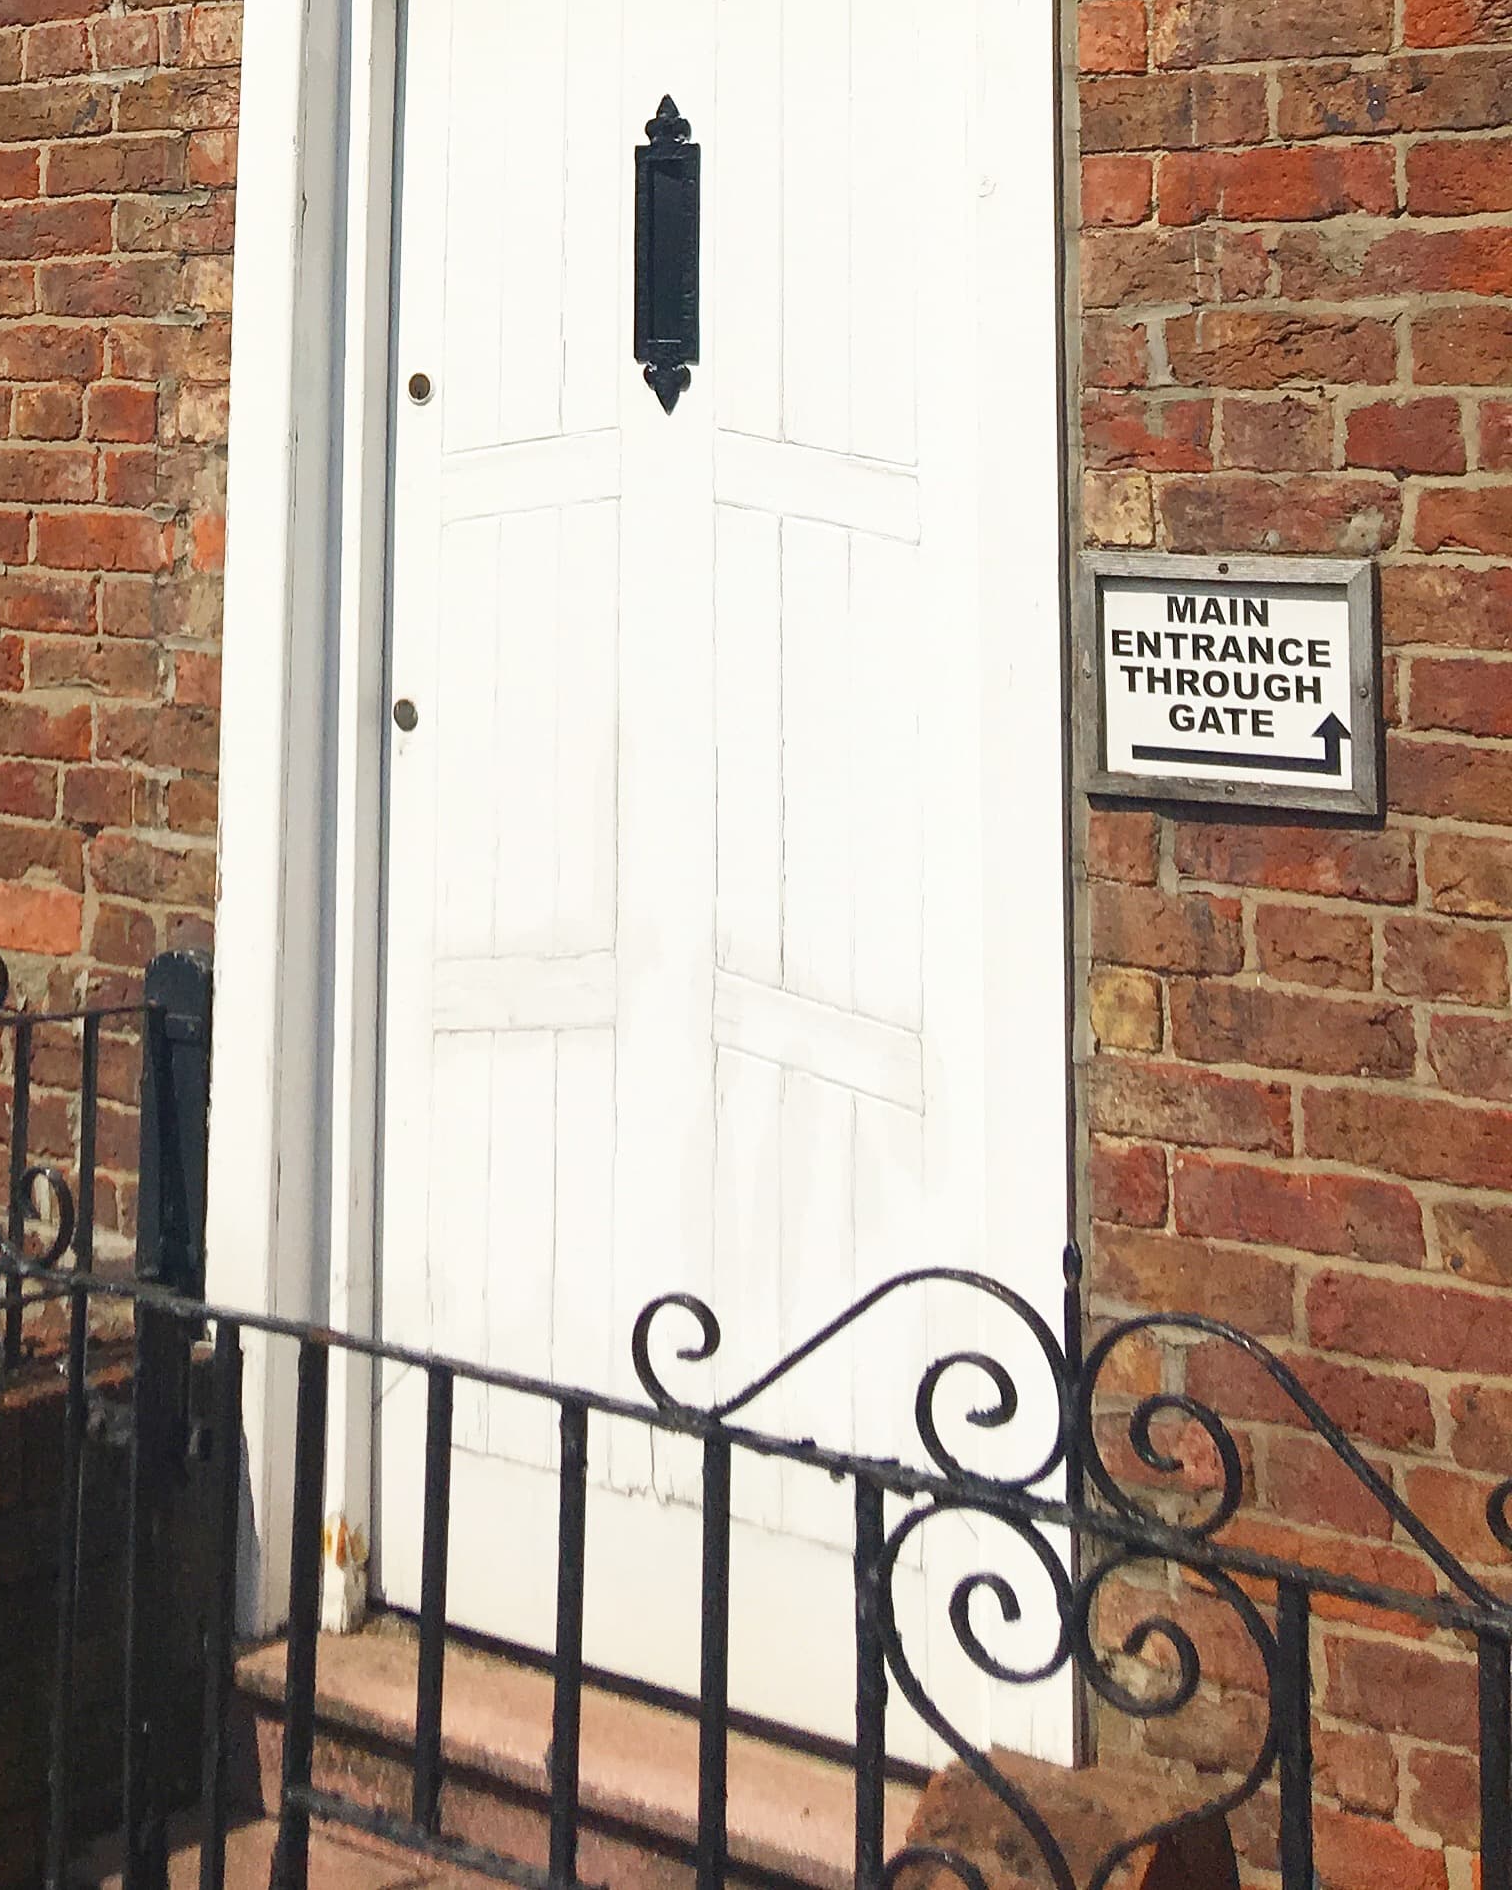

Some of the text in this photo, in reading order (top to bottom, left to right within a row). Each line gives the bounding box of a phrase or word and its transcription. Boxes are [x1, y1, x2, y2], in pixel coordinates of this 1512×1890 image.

[1166, 595, 1270, 628] MAIN
[1111, 629, 1332, 668] ENTRANCE
[1120, 665, 1322, 704] THROUGH
[1168, 704, 1275, 738] GATE
